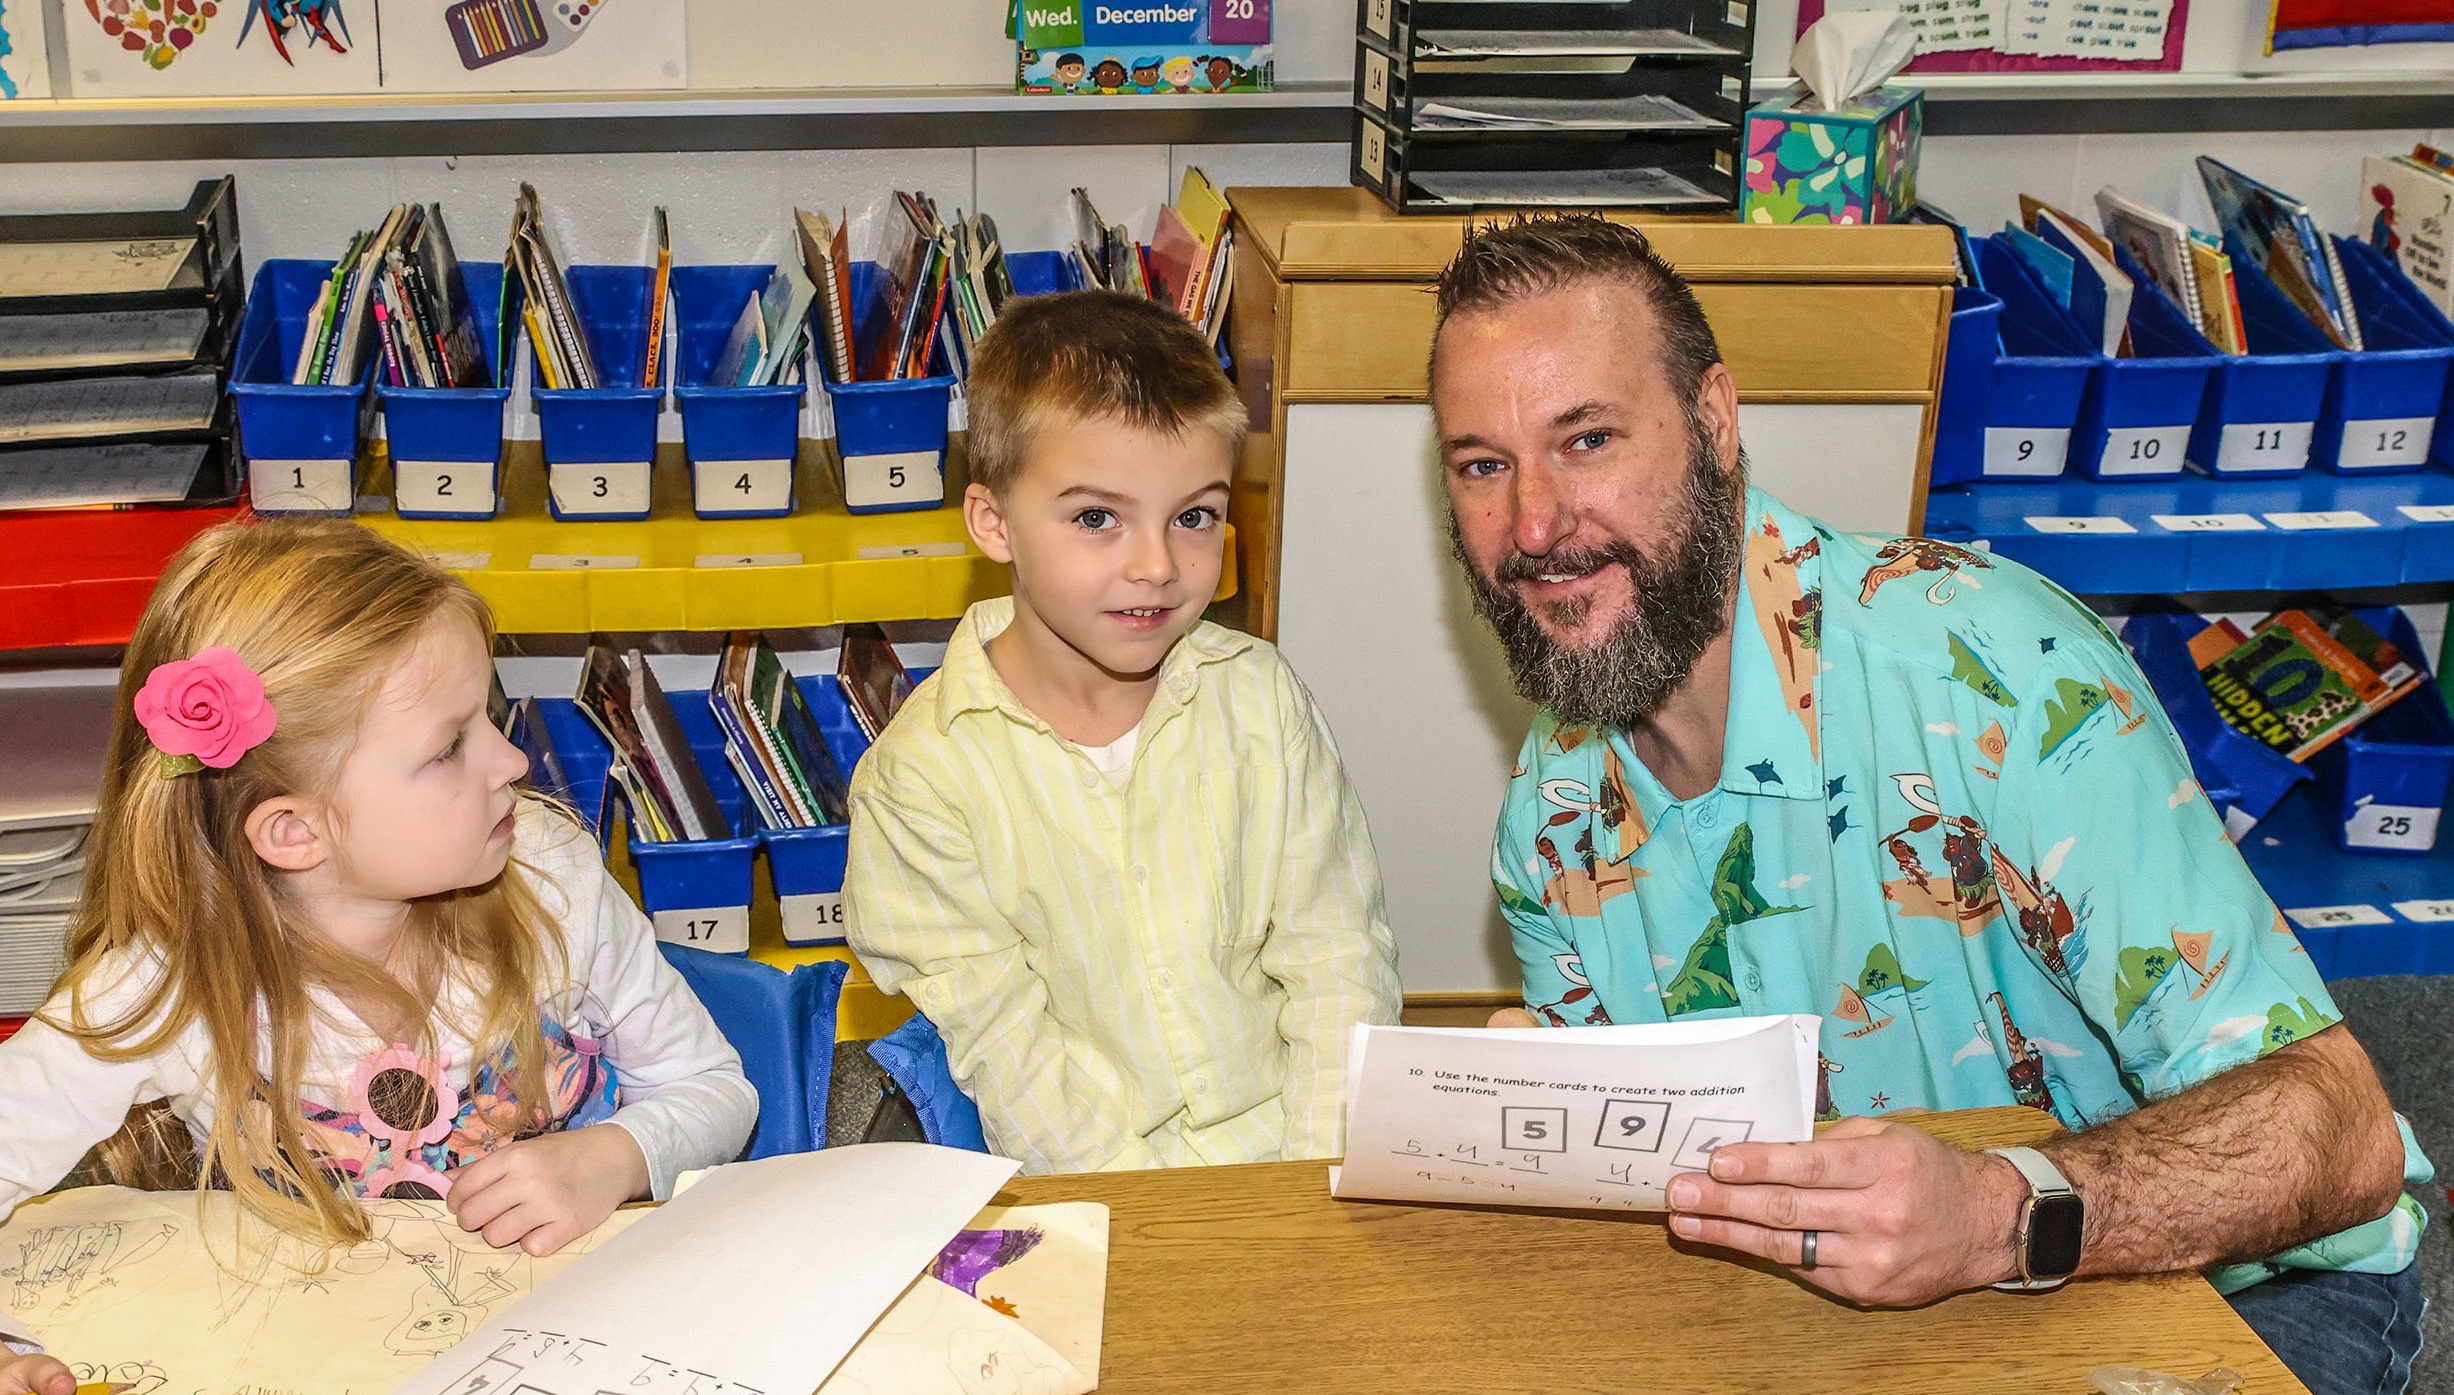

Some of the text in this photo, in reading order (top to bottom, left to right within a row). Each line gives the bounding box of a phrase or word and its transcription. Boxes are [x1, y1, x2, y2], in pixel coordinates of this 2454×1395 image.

[1025, 0, 1255, 28] Wed. December 20
[1372, 67, 1382, 92] 14
[1369, 138, 1379, 163] 13
[2017, 440, 2034, 461] 9
[2129, 438, 2161, 460] 10
[2254, 429, 2282, 451] 11
[2376, 431, 2408, 452] 12
[291, 466, 305, 490] 1
[436, 474, 453, 497] 2
[592, 476, 609, 498] 3
[734, 473, 752, 495] 4
[888, 465, 906, 488] 5
[2190, 518, 2225, 528] 10
[2222, 633, 2323, 710] 10
[2207, 671, 2294, 746] HIDDEN
[762, 780, 776, 800] VISIT
[773, 798, 783, 811] MY
[2377, 815, 2412, 836] 25
[816, 905, 844, 925] 18
[686, 919, 719, 941] 17
[1432, 1083, 1502, 1097] equations.
[1434, 1070, 1461, 1080] Use
[1466, 1074, 1489, 1083] the
[1493, 1078, 1545, 1088] number
[1549, 1081, 1588, 1092] cards
[1593, 1084, 1607, 1093] to
[1611, 1086, 1657, 1096] create
[1662, 1087, 1686, 1096] two
[1690, 1085, 1745, 1097] addition
[1522, 1120, 1547, 1139] 5
[1620, 1116, 1647, 1137] 9
[1406, 1139, 1422, 1154] 5
